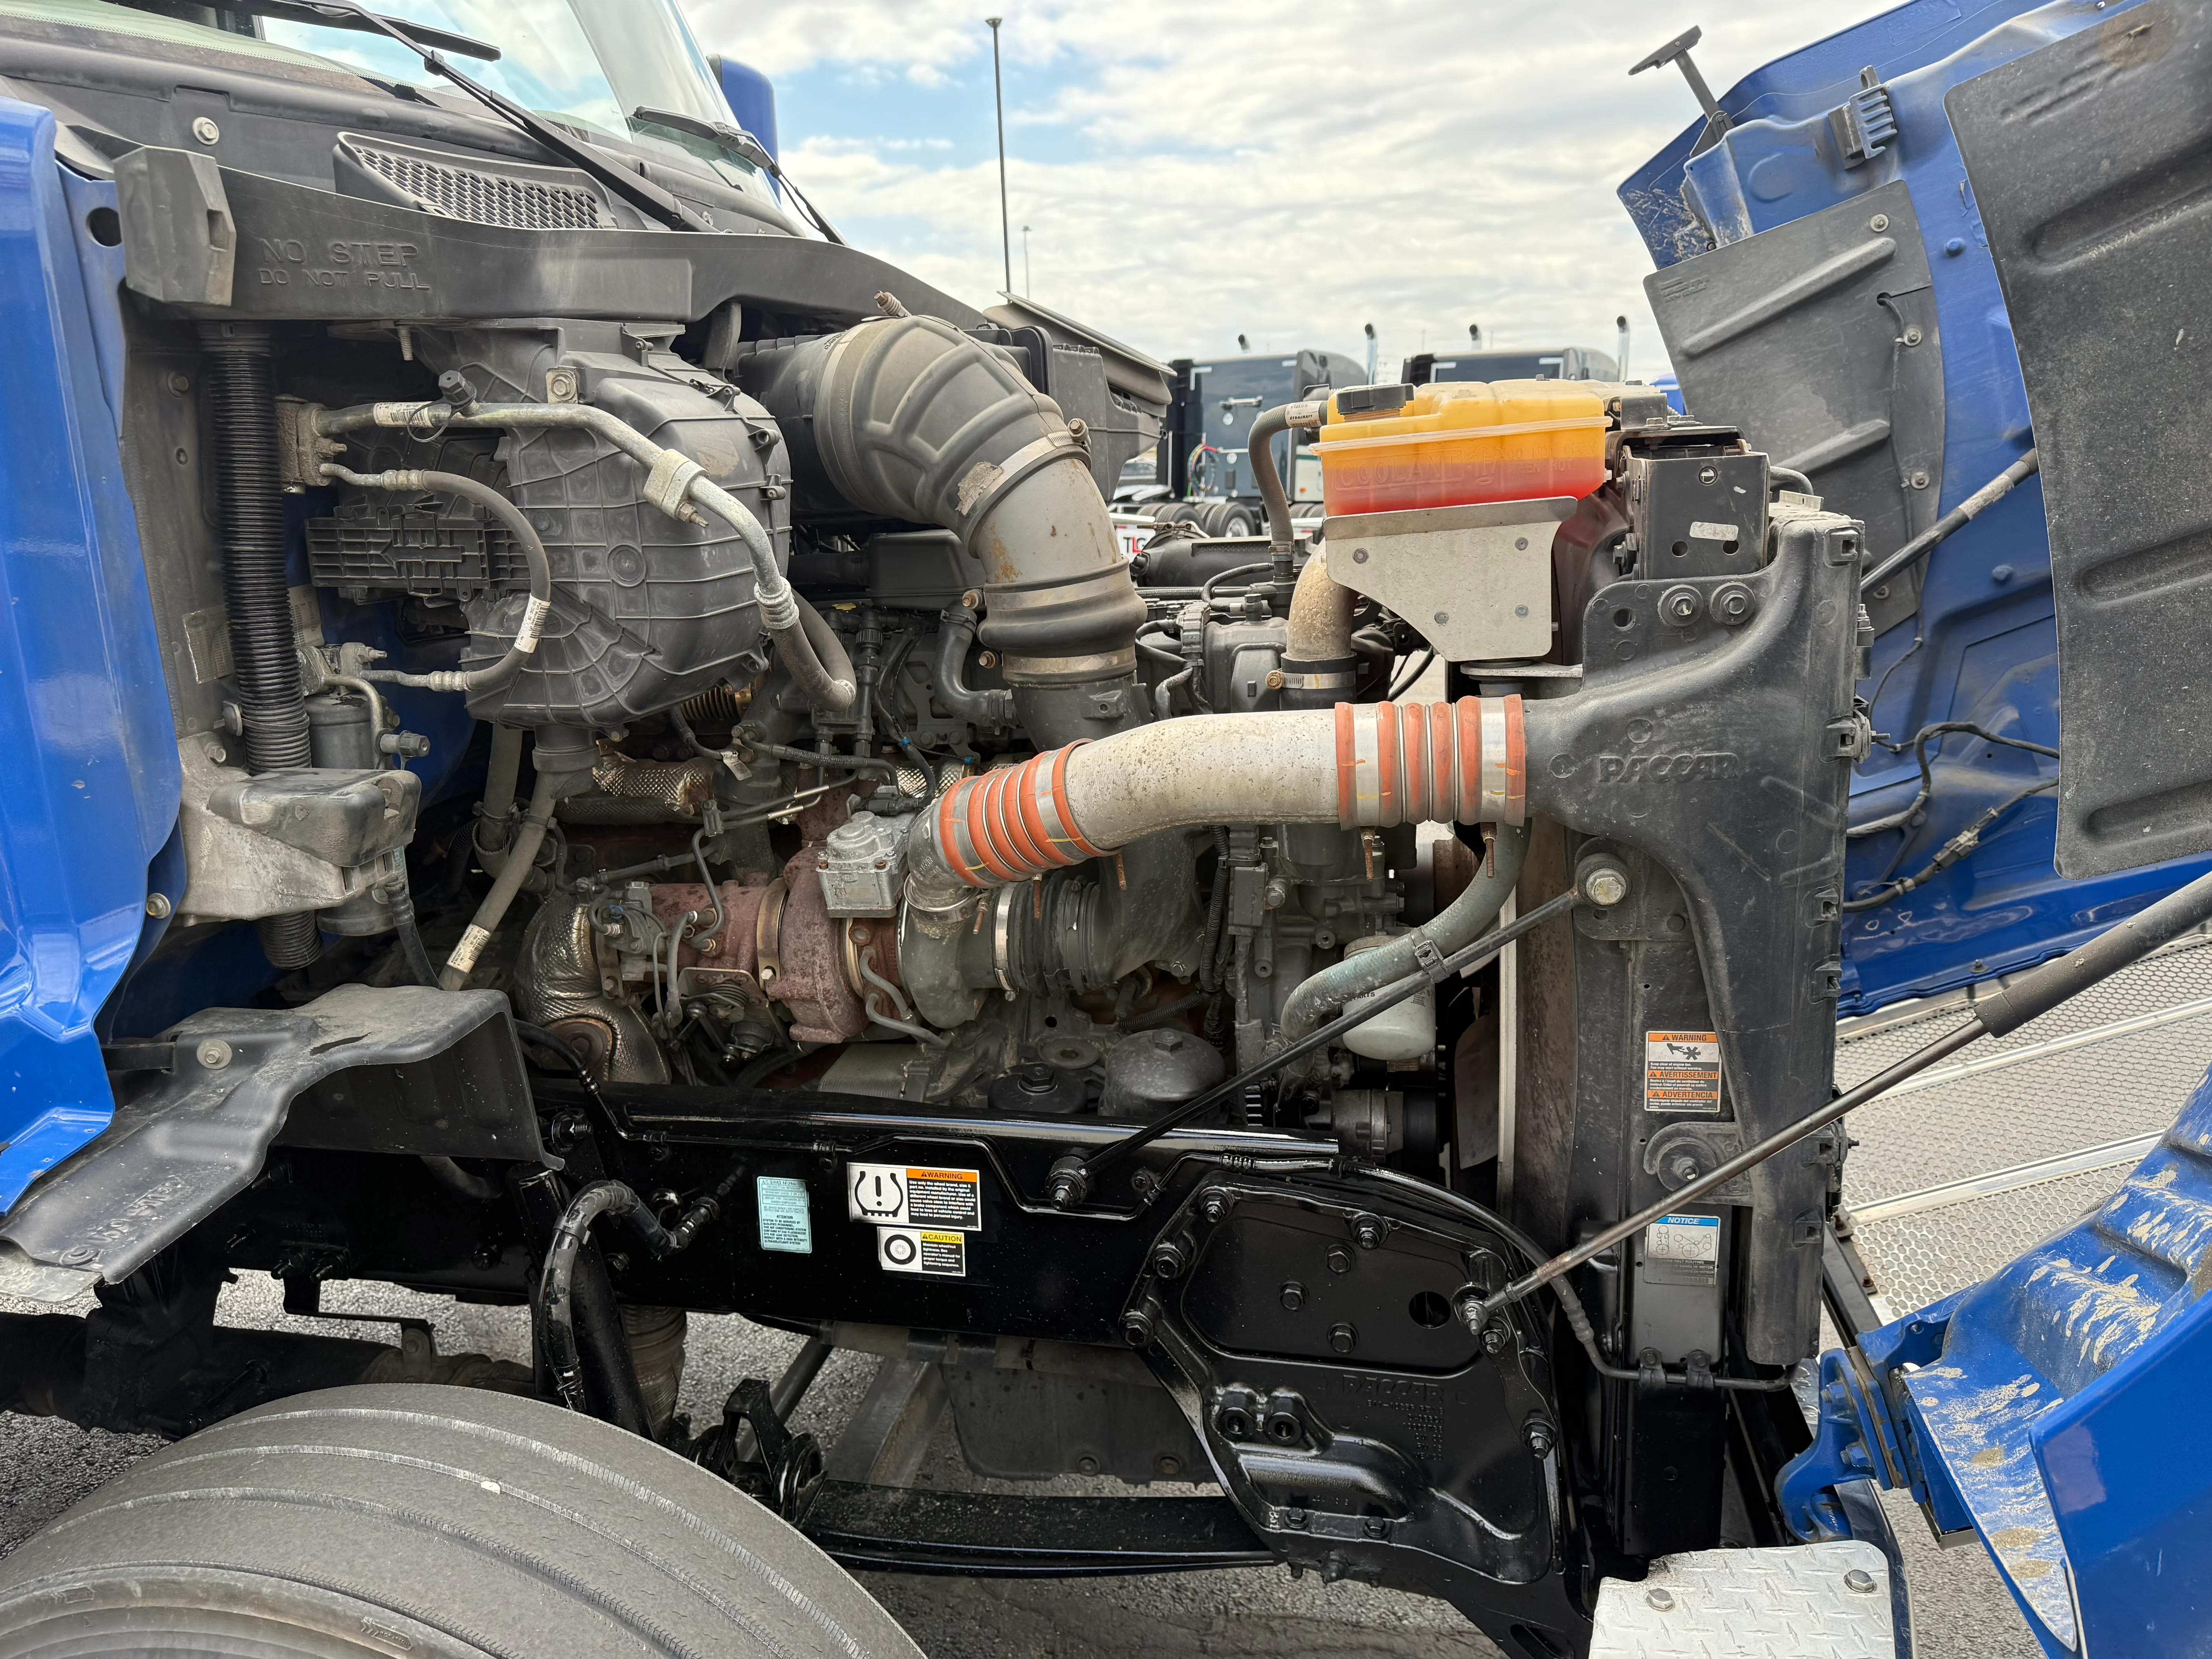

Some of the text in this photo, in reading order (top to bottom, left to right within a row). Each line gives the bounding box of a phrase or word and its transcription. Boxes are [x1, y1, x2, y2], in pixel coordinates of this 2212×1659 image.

[259, 239, 419, 266] NO STEP
[259, 268, 430, 289] DO NOT PULL
[1532, 447, 1553, 459] NOT
[1563, 445, 1596, 456] OPEN
[1340, 453, 1459, 486] COOLANT
[1599, 752, 1739, 783] PACCAR
[1668, 1217, 1699, 1225] NOTICE
[1343, 1375, 1444, 1403] PACCAR
